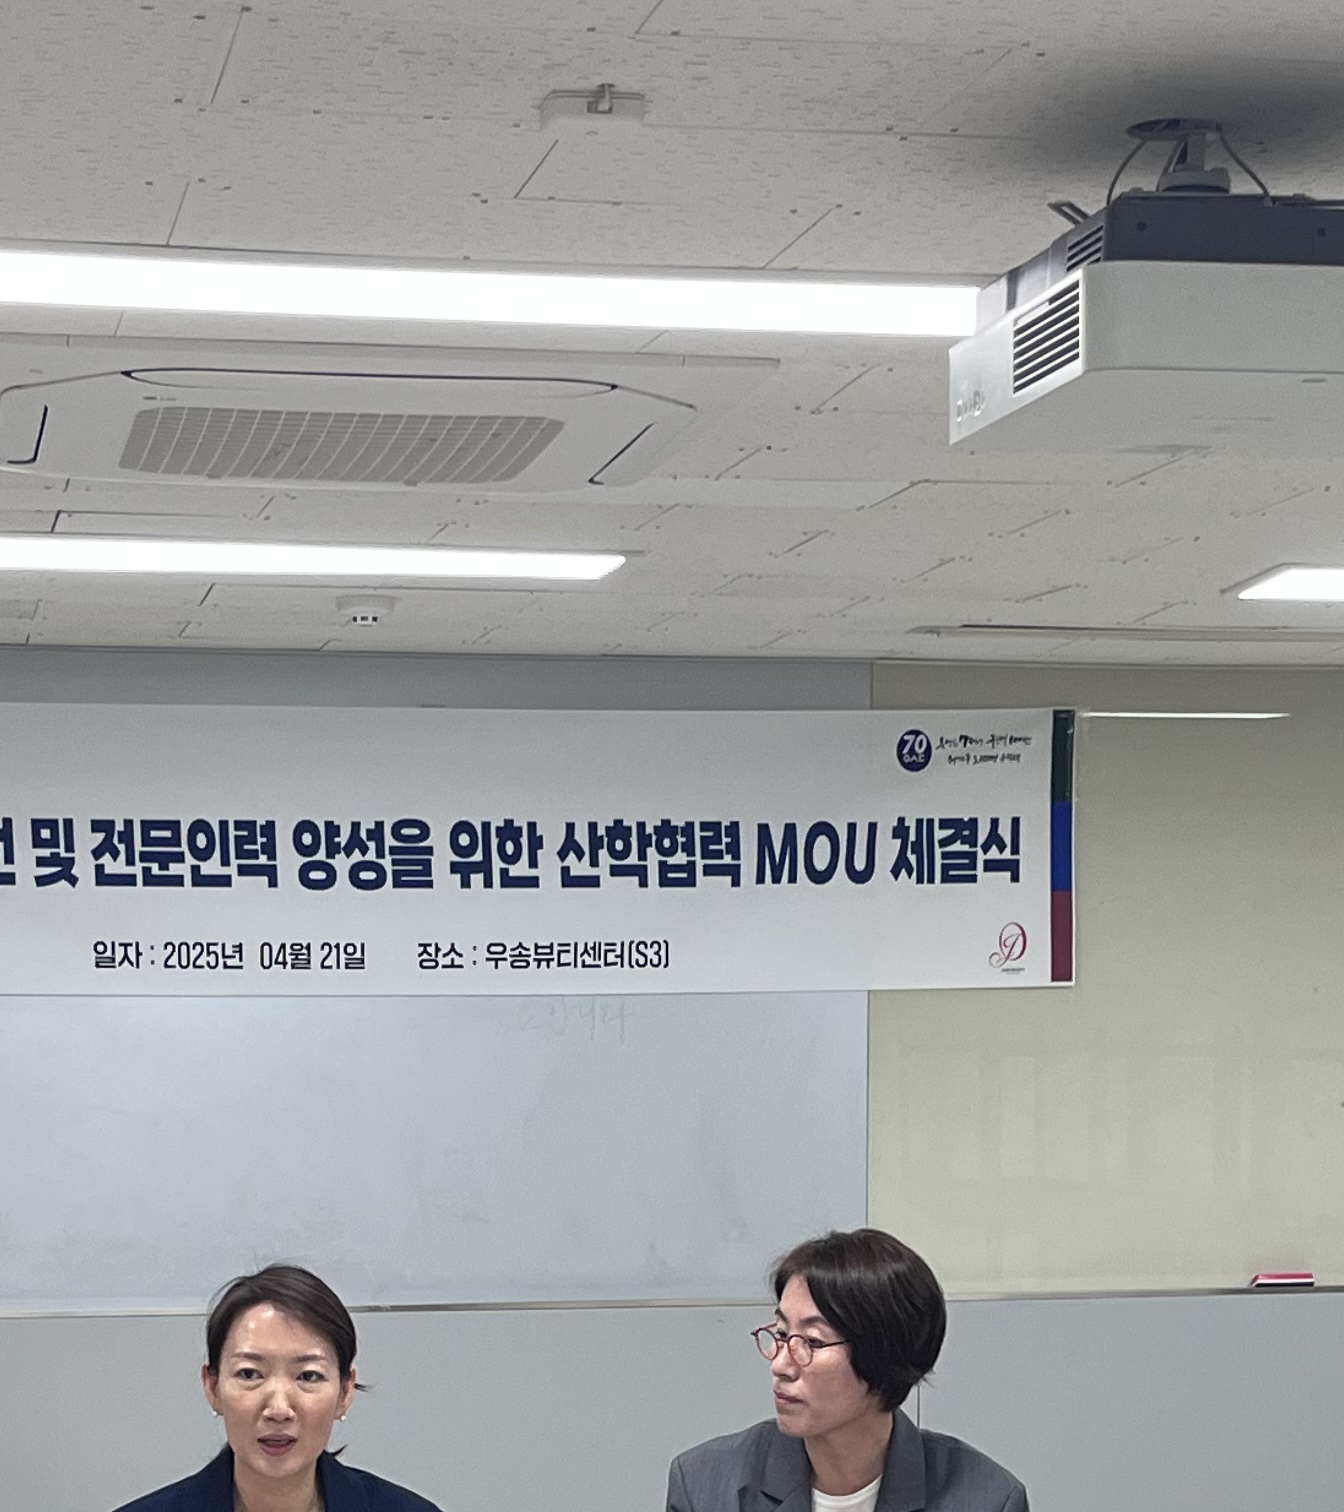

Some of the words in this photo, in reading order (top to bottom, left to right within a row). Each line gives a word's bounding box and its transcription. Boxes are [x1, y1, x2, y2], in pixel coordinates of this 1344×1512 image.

[902, 734, 928, 754] 70
[30, 817, 80, 889] 및
[89, 818, 279, 889] 전문인력
[292, 818, 434, 891] 양성을
[449, 818, 544, 889] 위한
[556, 818, 742, 889] 산학협력
[755, 820, 879, 885] MOU
[889, 815, 1021, 885] 체결식
[93, 940, 143, 969] 일자
[163, 941, 244, 970] 2025년
[259, 941, 312, 970] 04월
[319, 941, 366, 970] 21일
[417, 941, 465, 970] 장소
[485, 940, 670, 970] 우송뷰티센터(S3)
